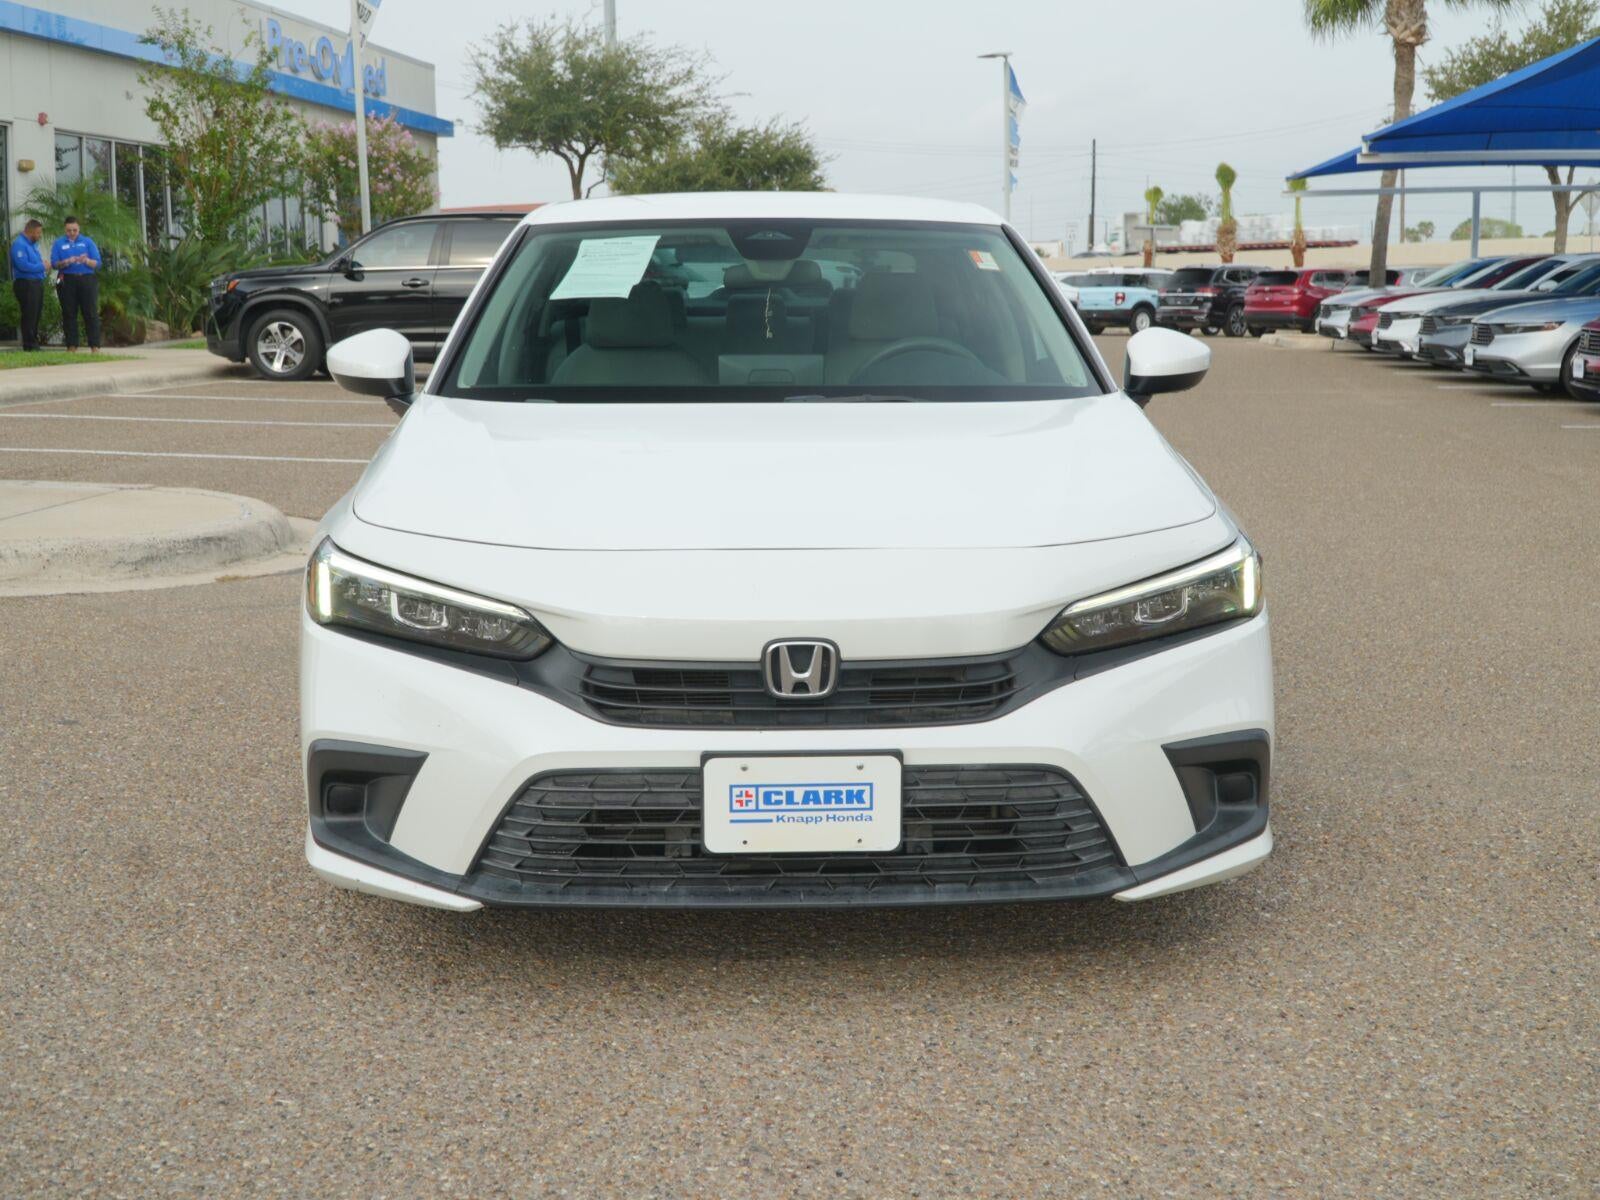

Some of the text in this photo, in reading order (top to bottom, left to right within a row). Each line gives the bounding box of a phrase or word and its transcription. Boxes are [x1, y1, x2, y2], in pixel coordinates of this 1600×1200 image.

[266, 17, 386, 97] Pre-Oed
[763, 789, 866, 806] CLARK
[776, 813, 873, 824] Knapp Honda
